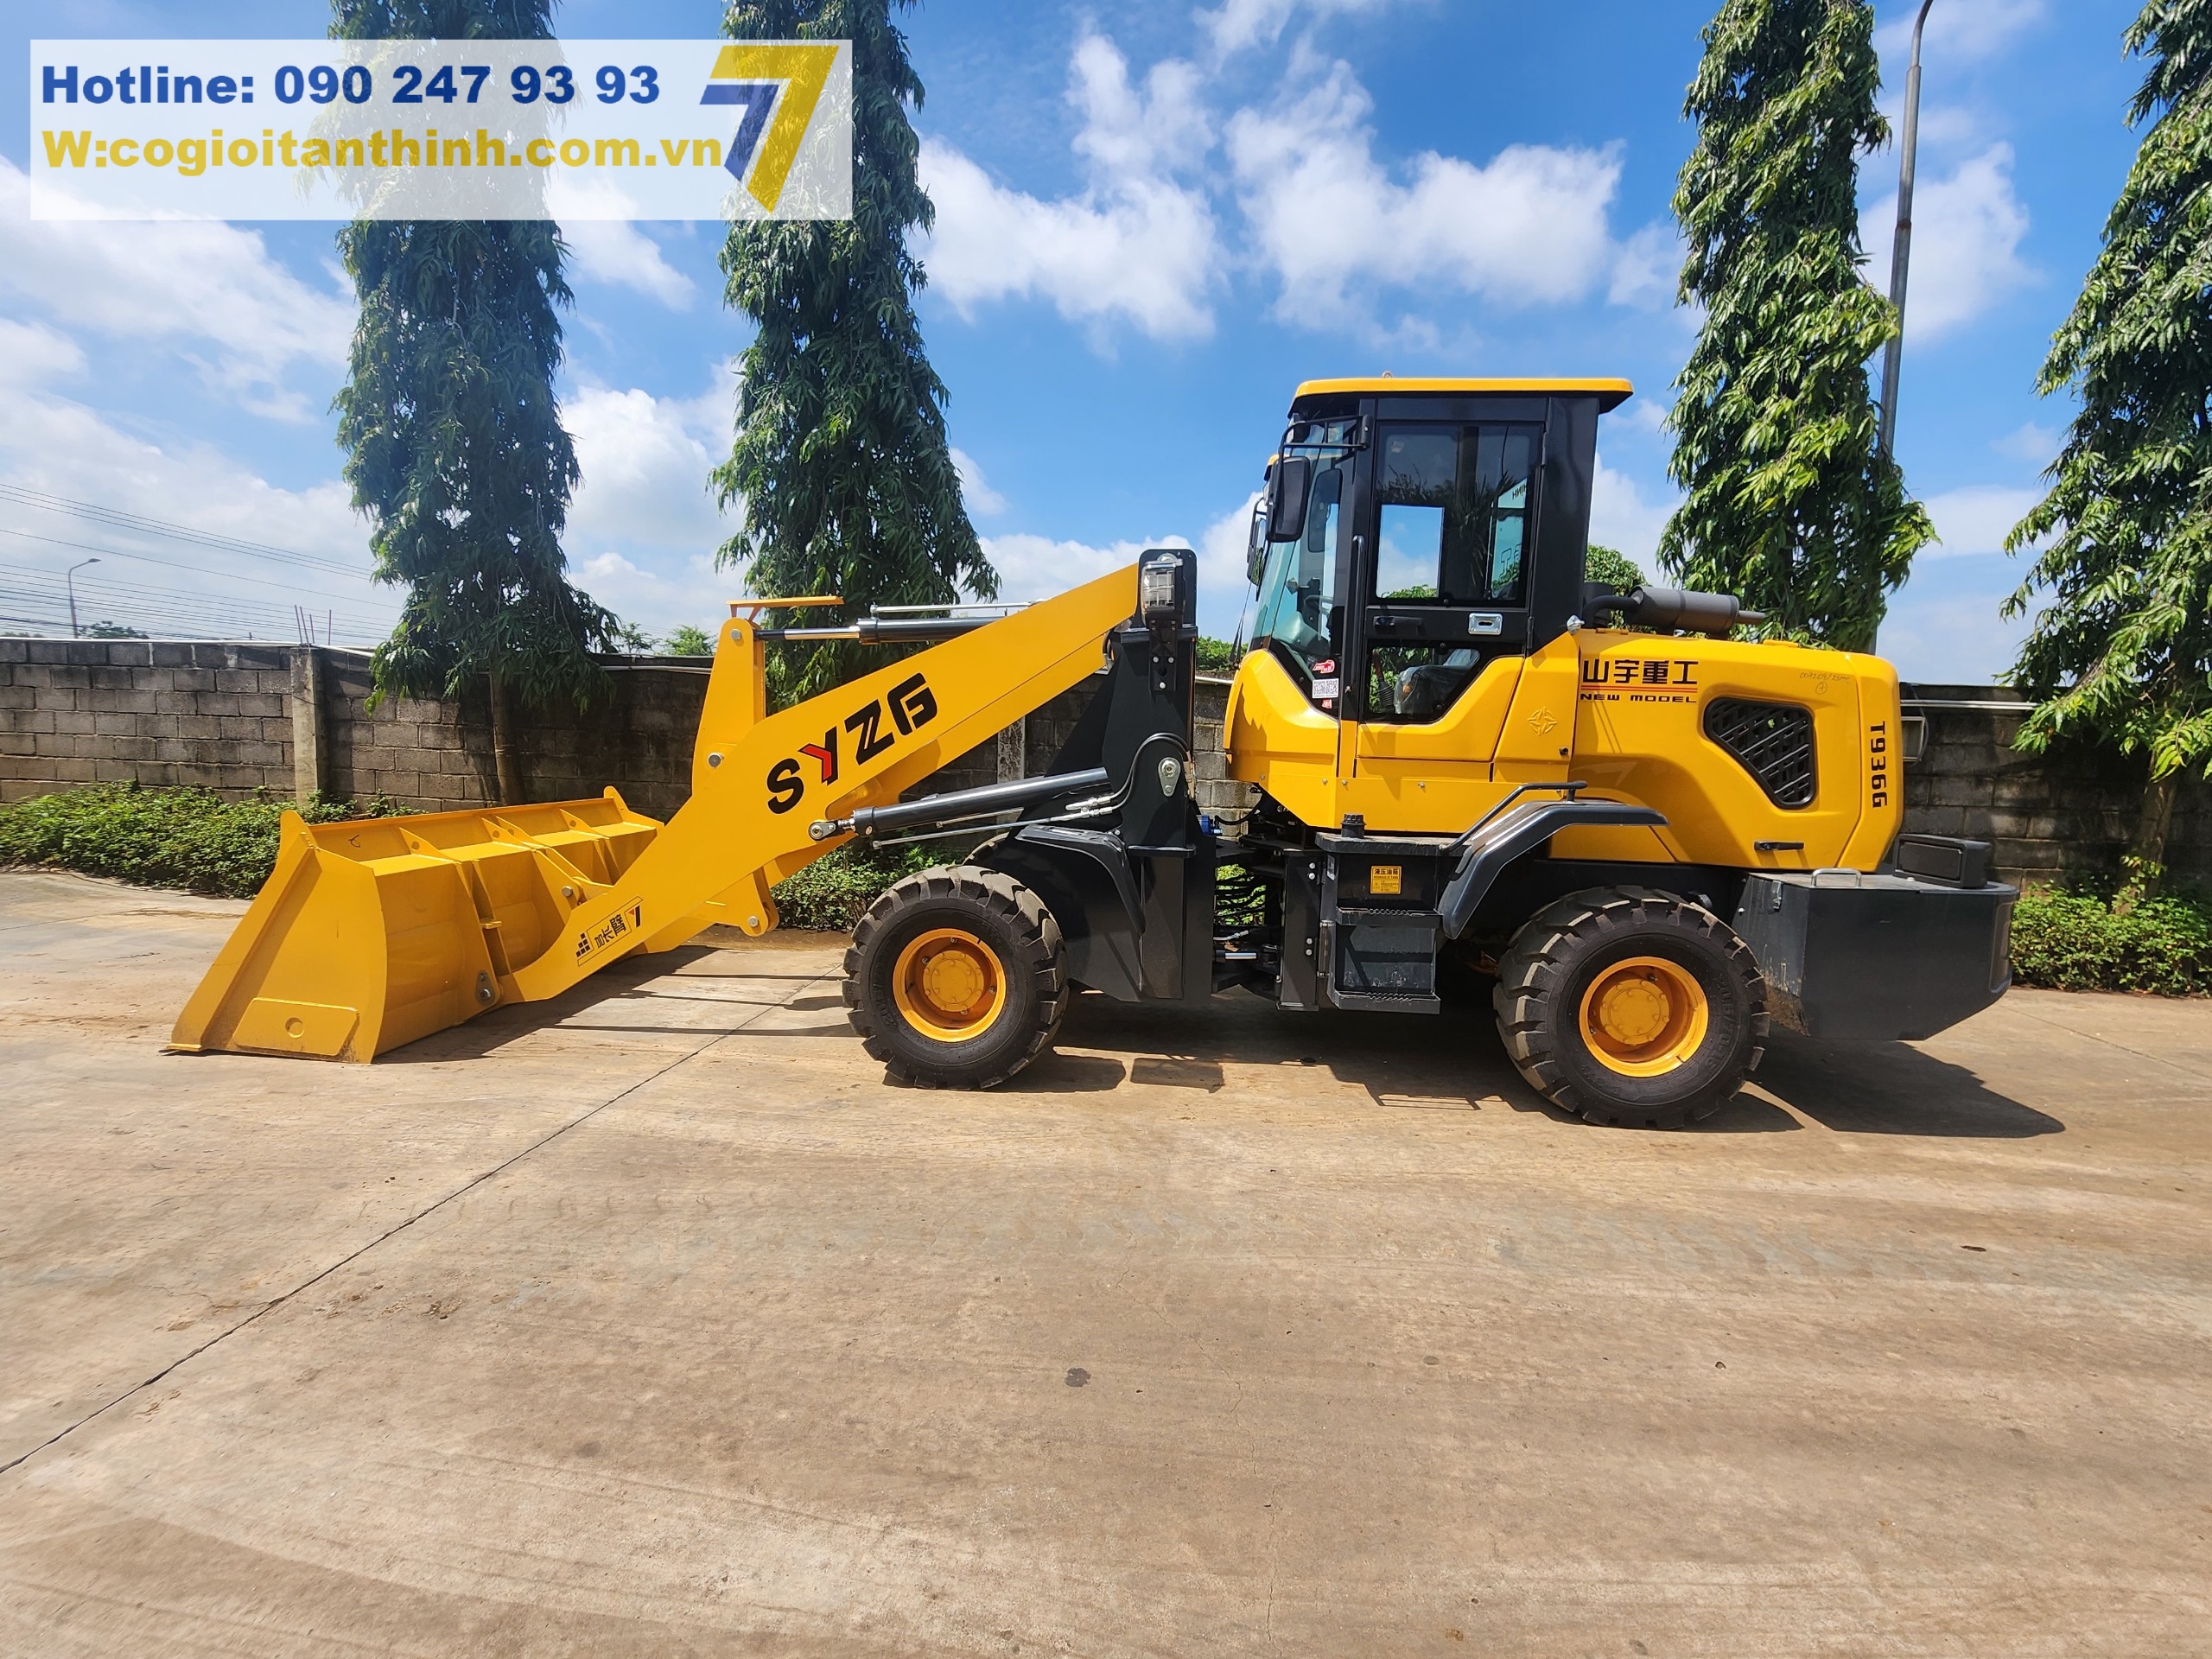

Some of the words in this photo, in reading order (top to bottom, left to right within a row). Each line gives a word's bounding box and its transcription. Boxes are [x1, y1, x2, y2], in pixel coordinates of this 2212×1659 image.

[1580, 692, 1620, 701] NEW
[1630, 694, 1698, 703] MODEL
[1582, 658, 1700, 684] 山宇重工
[766, 671, 938, 815] SYZG
[1870, 720, 1888, 809] T936G
